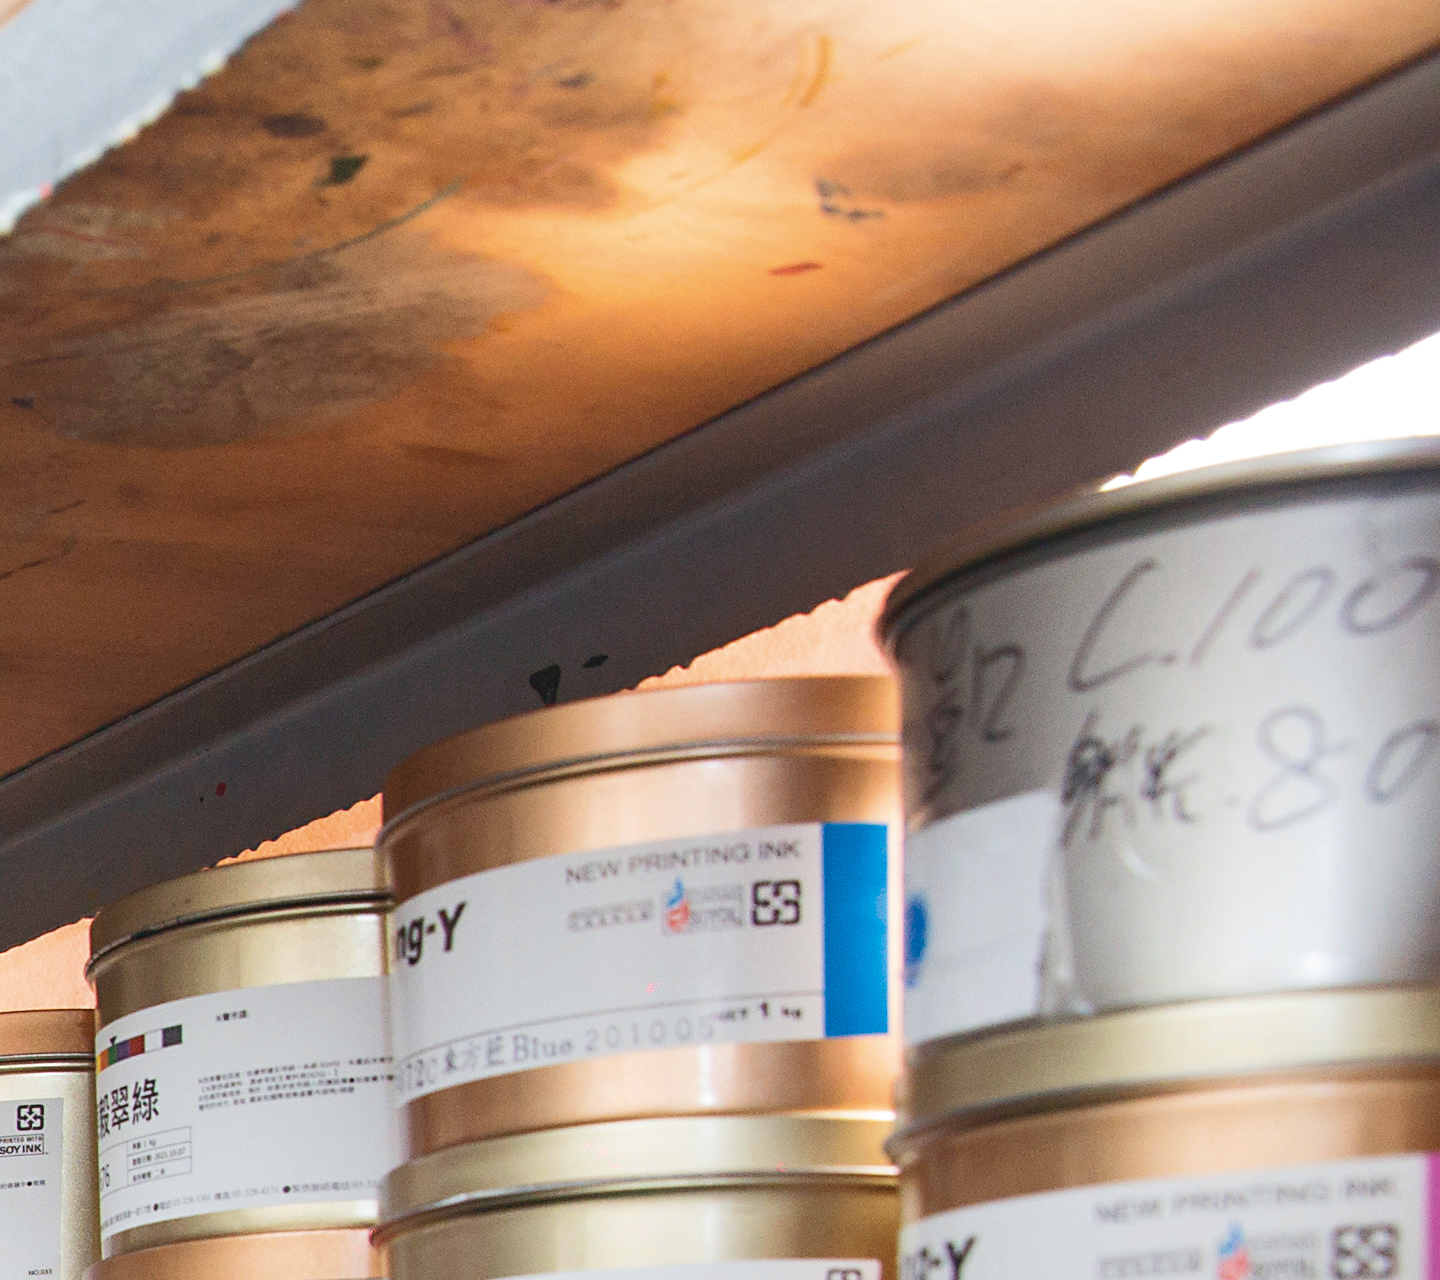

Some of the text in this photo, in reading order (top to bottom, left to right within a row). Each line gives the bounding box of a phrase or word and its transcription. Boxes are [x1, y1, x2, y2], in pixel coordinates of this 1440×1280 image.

[566, 839, 801, 885] NEW PRINTING INK
[0, 1143, 43, 1155] SOY INK
